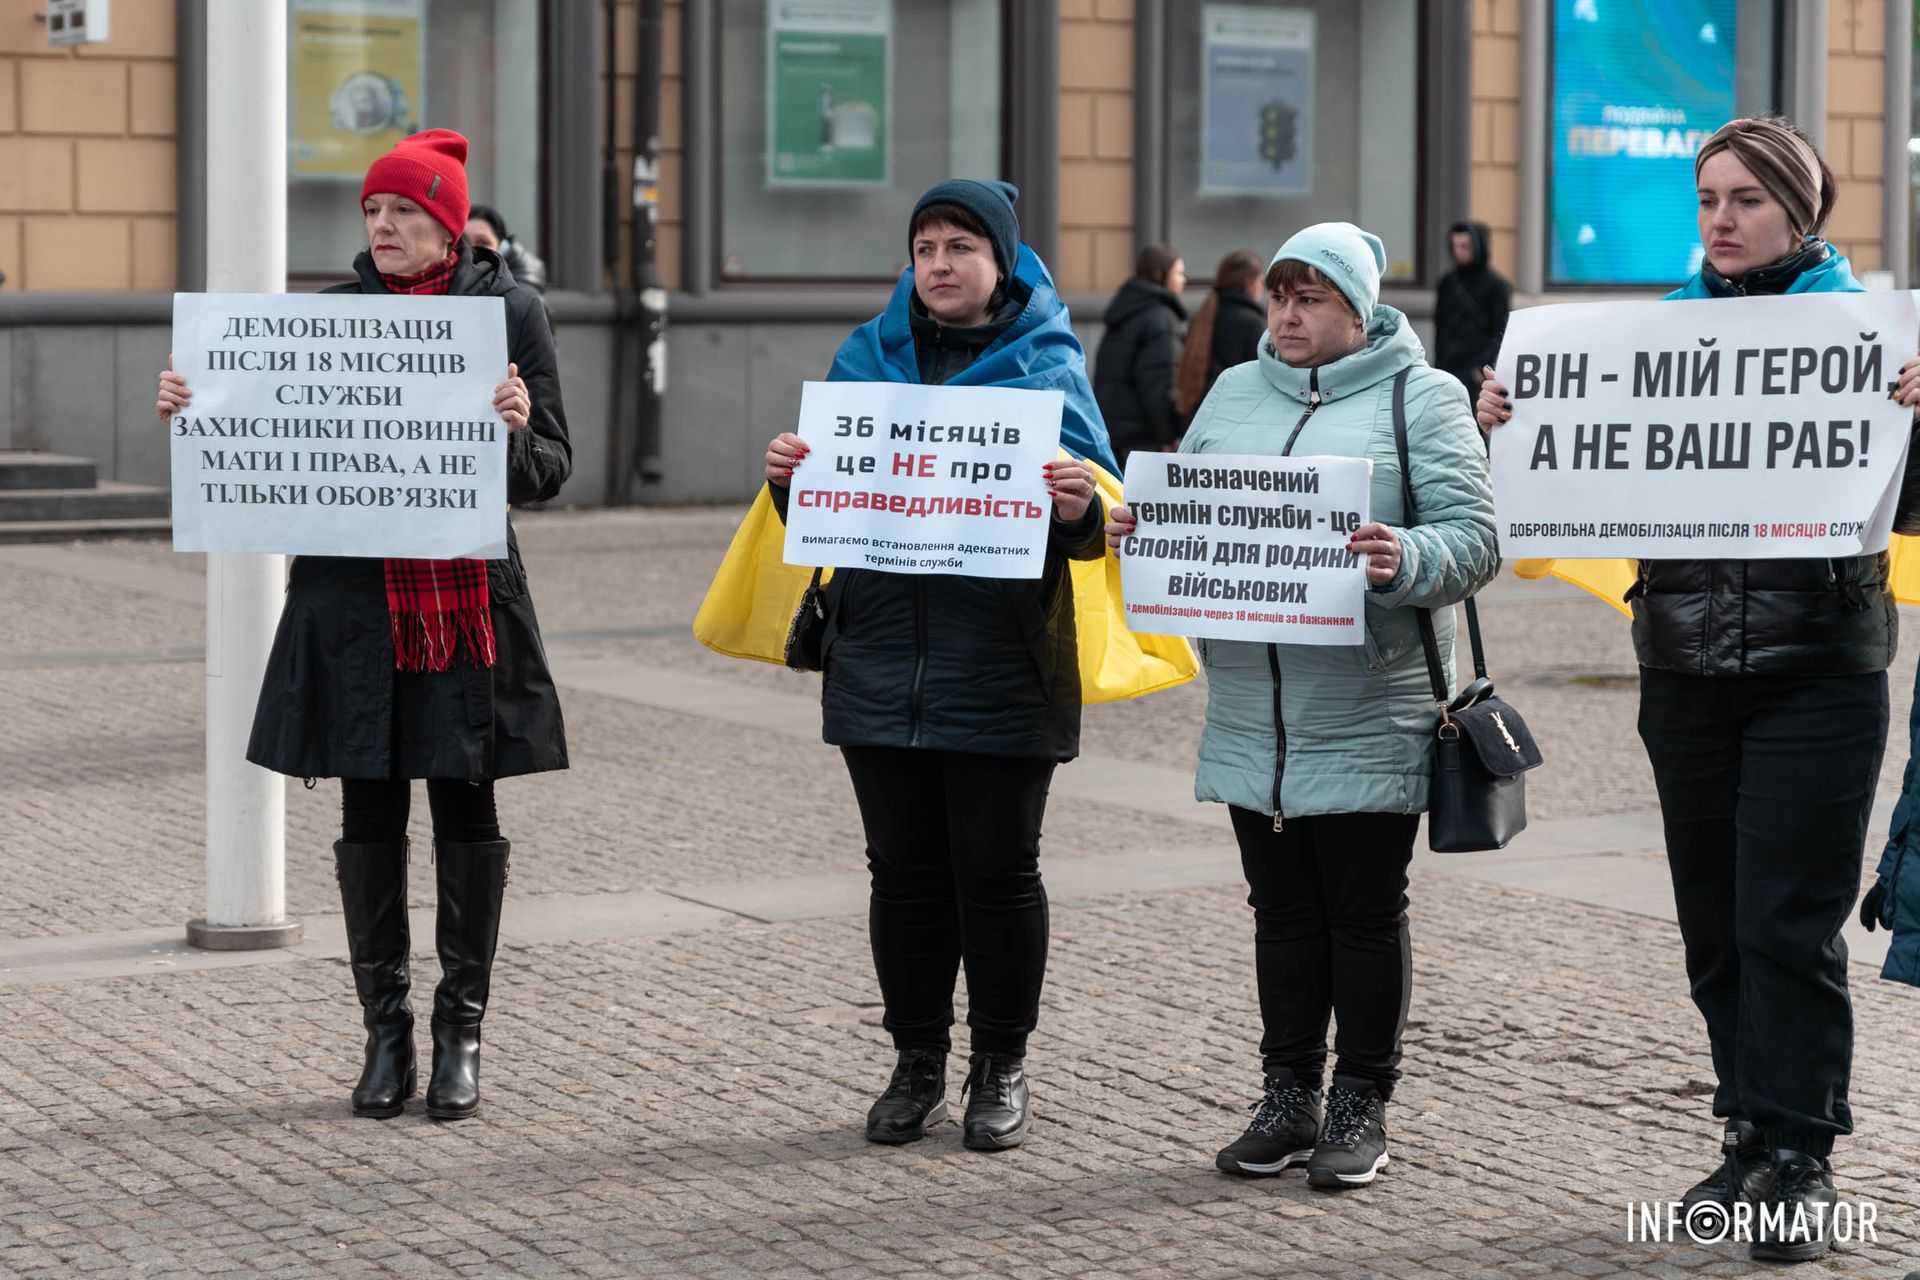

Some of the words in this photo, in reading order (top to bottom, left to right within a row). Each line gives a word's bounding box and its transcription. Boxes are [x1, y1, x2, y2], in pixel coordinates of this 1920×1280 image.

[1570, 127, 1714, 158] ПЕРЕВАГ
[223, 318, 452, 342] ДЕМОБІЛІЗАЦІЯ
[208, 351, 296, 371] ПІСЛЯ
[308, 352, 332, 371] 18
[341, 352, 465, 376] МІСЯЦІВ
[1515, 353, 1588, 399] ВІН
[1601, 374, 1618, 382] -
[1633, 338, 1720, 397] МІЙ
[276, 385, 402, 406] СЛУЖБИ
[175, 417, 353, 439] ЗАХИСНИКИ
[364, 420, 495, 442] ПОВИННІ
[834, 416, 873, 437] 36
[890, 420, 1020, 446] місяців
[1530, 425, 1558, 470] А
[1573, 424, 1631, 469] НЕ
[1646, 422, 1751, 470] ВАШ
[1767, 420, 1870, 469] РАБ!
[202, 450, 282, 471] МАТИ
[293, 452, 299, 471] І
[310, 452, 405, 476] ПРАВА,
[413, 455, 431, 474] А
[440, 455, 476, 475] НЕ
[836, 456, 875, 475] це
[892, 453, 937, 477] НЕ
[951, 462, 1011, 484] про
[1167, 463, 1319, 494] Визначений
[201, 483, 308, 504] ТІЛЬКИ
[798, 490, 1042, 518] справедливість
[1127, 500, 1211, 526] термін
[1218, 504, 1311, 530] служби
[1331, 511, 1361, 533] це
[1510, 523, 1595, 538] ДОБРОВІЛЬНА
[1599, 523, 1704, 539] ДЕМОБІЛІЗАЦІЯ
[1709, 524, 1749, 537] ПІСЛЯ
[1753, 524, 1768, 537] 18
[1771, 523, 1826, 538] МІСЯЦІВ
[802, 536, 869, 545] вимагаємо
[872, 539, 954, 550] встановлення
[958, 544, 1029, 555] адекватних
[1124, 534, 1208, 561] спокій
[1212, 542, 1261, 566] для
[1265, 543, 1359, 570] родини
[864, 554, 916, 568] термінів
[920, 558, 962, 569] служби
[1168, 571, 1309, 604] військових
[1132, 604, 1202, 617] демобілізацію
[1204, 610, 1233, 620] через
[1236, 610, 1245, 621] 18
[1248, 612, 1284, 623] місяців
[1286, 615, 1297, 623] за
[1300, 614, 1354, 626] бажанням
